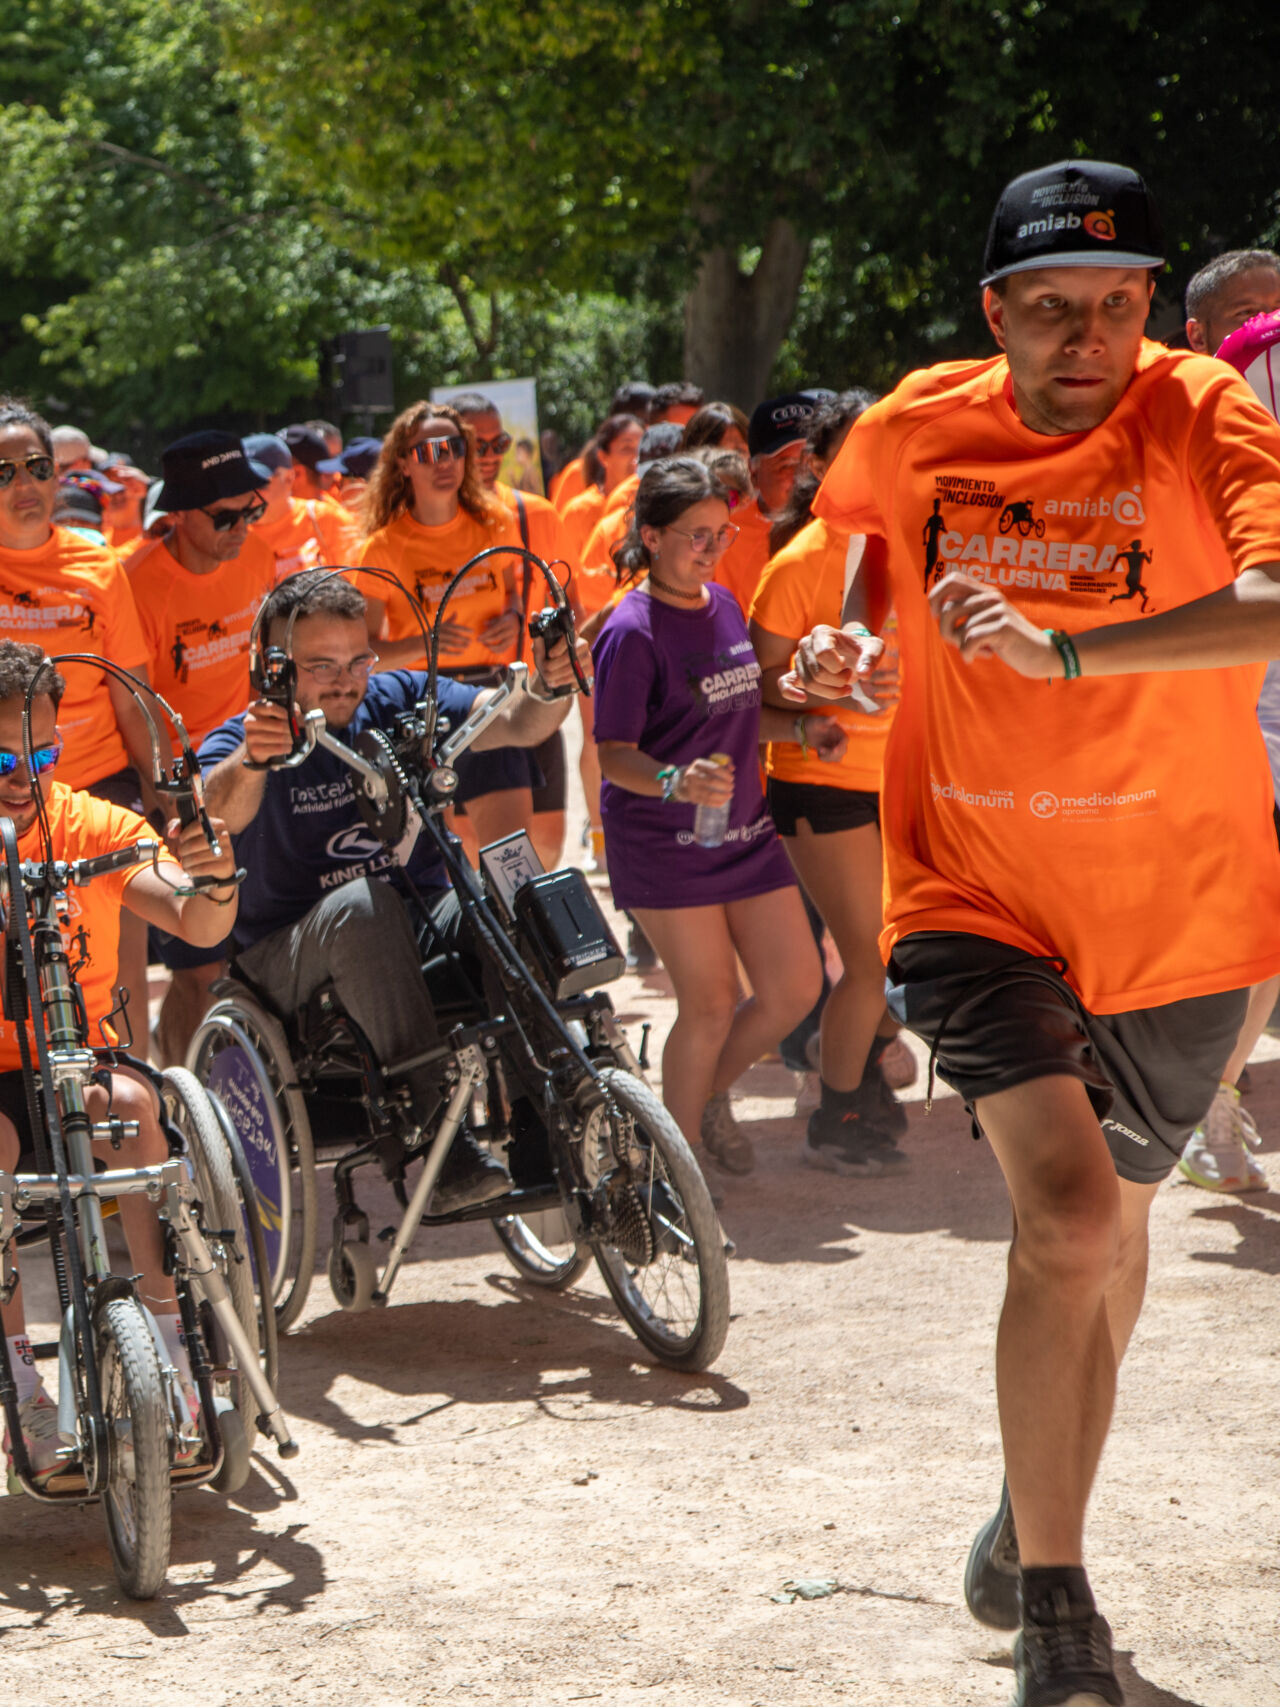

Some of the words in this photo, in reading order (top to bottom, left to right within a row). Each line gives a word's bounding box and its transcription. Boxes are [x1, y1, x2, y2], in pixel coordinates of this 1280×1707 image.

[1017, 212, 1082, 238] amiab
[935, 475, 996, 492] MOVIMIENTO
[943, 489, 1006, 508] INCLUSIÓN
[1044, 496, 1111, 517] amiab
[939, 530, 1124, 573] CARRERA
[1062, 789, 1157, 808] mediolanum
[320, 863, 366, 889] KING
